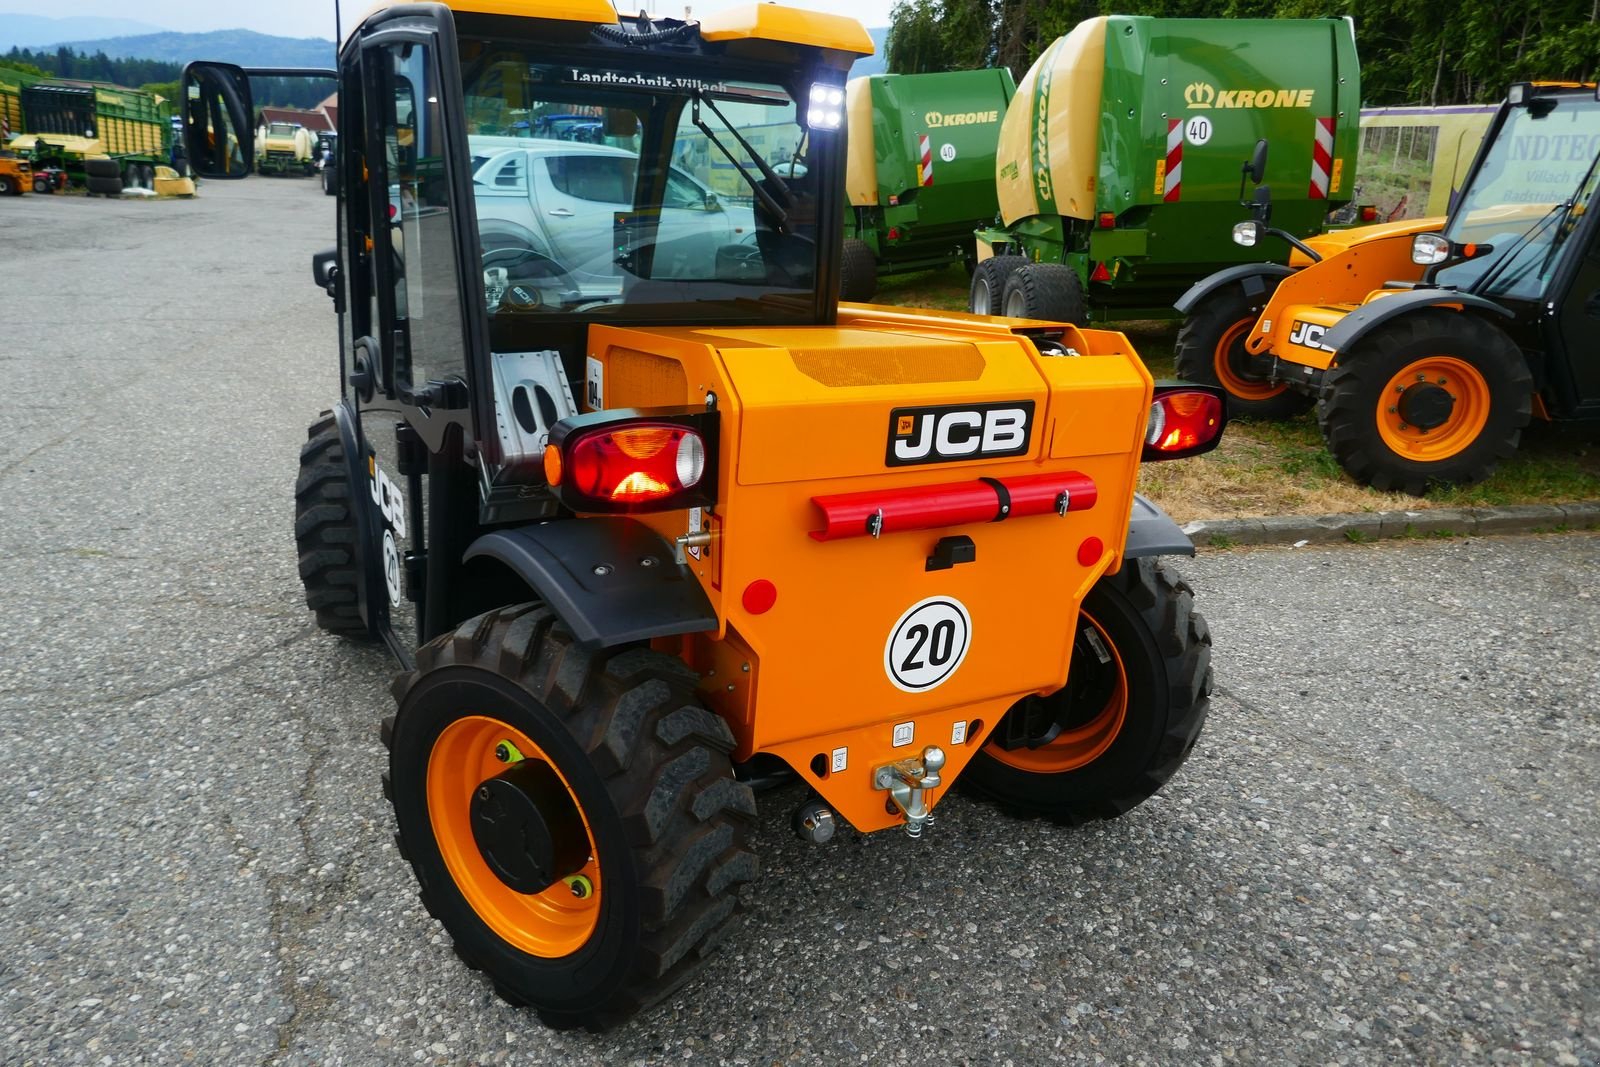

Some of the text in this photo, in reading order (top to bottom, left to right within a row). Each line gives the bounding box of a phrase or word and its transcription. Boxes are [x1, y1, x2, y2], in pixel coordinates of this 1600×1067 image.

[1214, 89, 1315, 109] KRONE
[943, 111, 998, 127] KRONE
[1037, 69, 1051, 169] KRON
[1189, 121, 1208, 140] 40
[943, 146, 953, 159] 40
[1526, 170, 1570, 184] Villach
[895, 408, 1027, 459] JCB
[370, 463, 406, 539] JCB
[900, 619, 956, 672] 20
